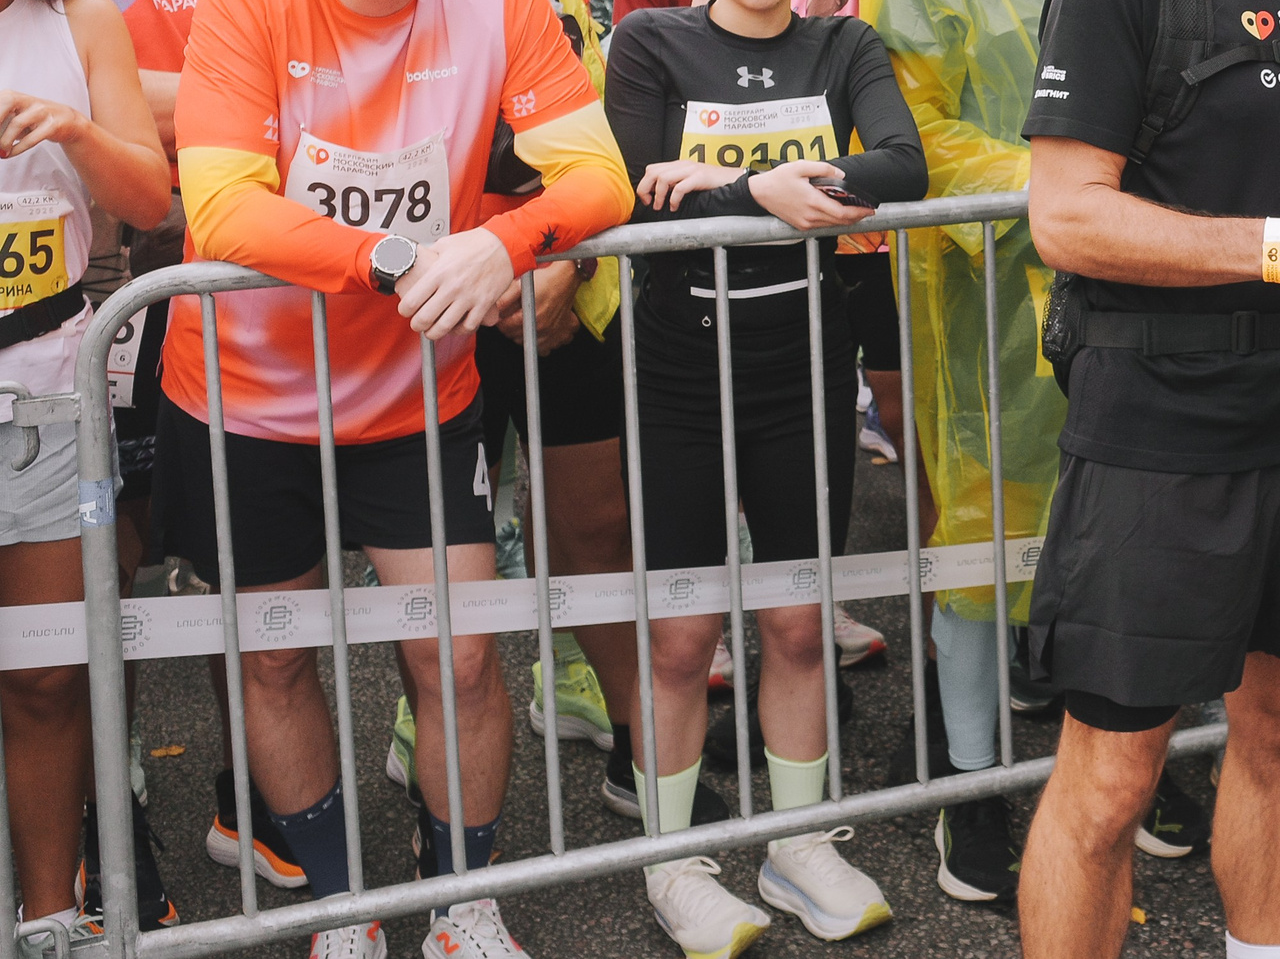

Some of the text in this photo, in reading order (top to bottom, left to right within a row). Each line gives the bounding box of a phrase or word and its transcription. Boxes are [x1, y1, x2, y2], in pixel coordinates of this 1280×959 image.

[406, 65, 458, 83] bodycore
[724, 112, 778, 123] МОСКОВСКИЙ
[724, 122, 766, 130] МАРАФОН
[333, 157, 395, 171] МОСКОВСКИЙ
[332, 165, 379, 177] МАРАФОН
[307, 180, 432, 229] 3078
